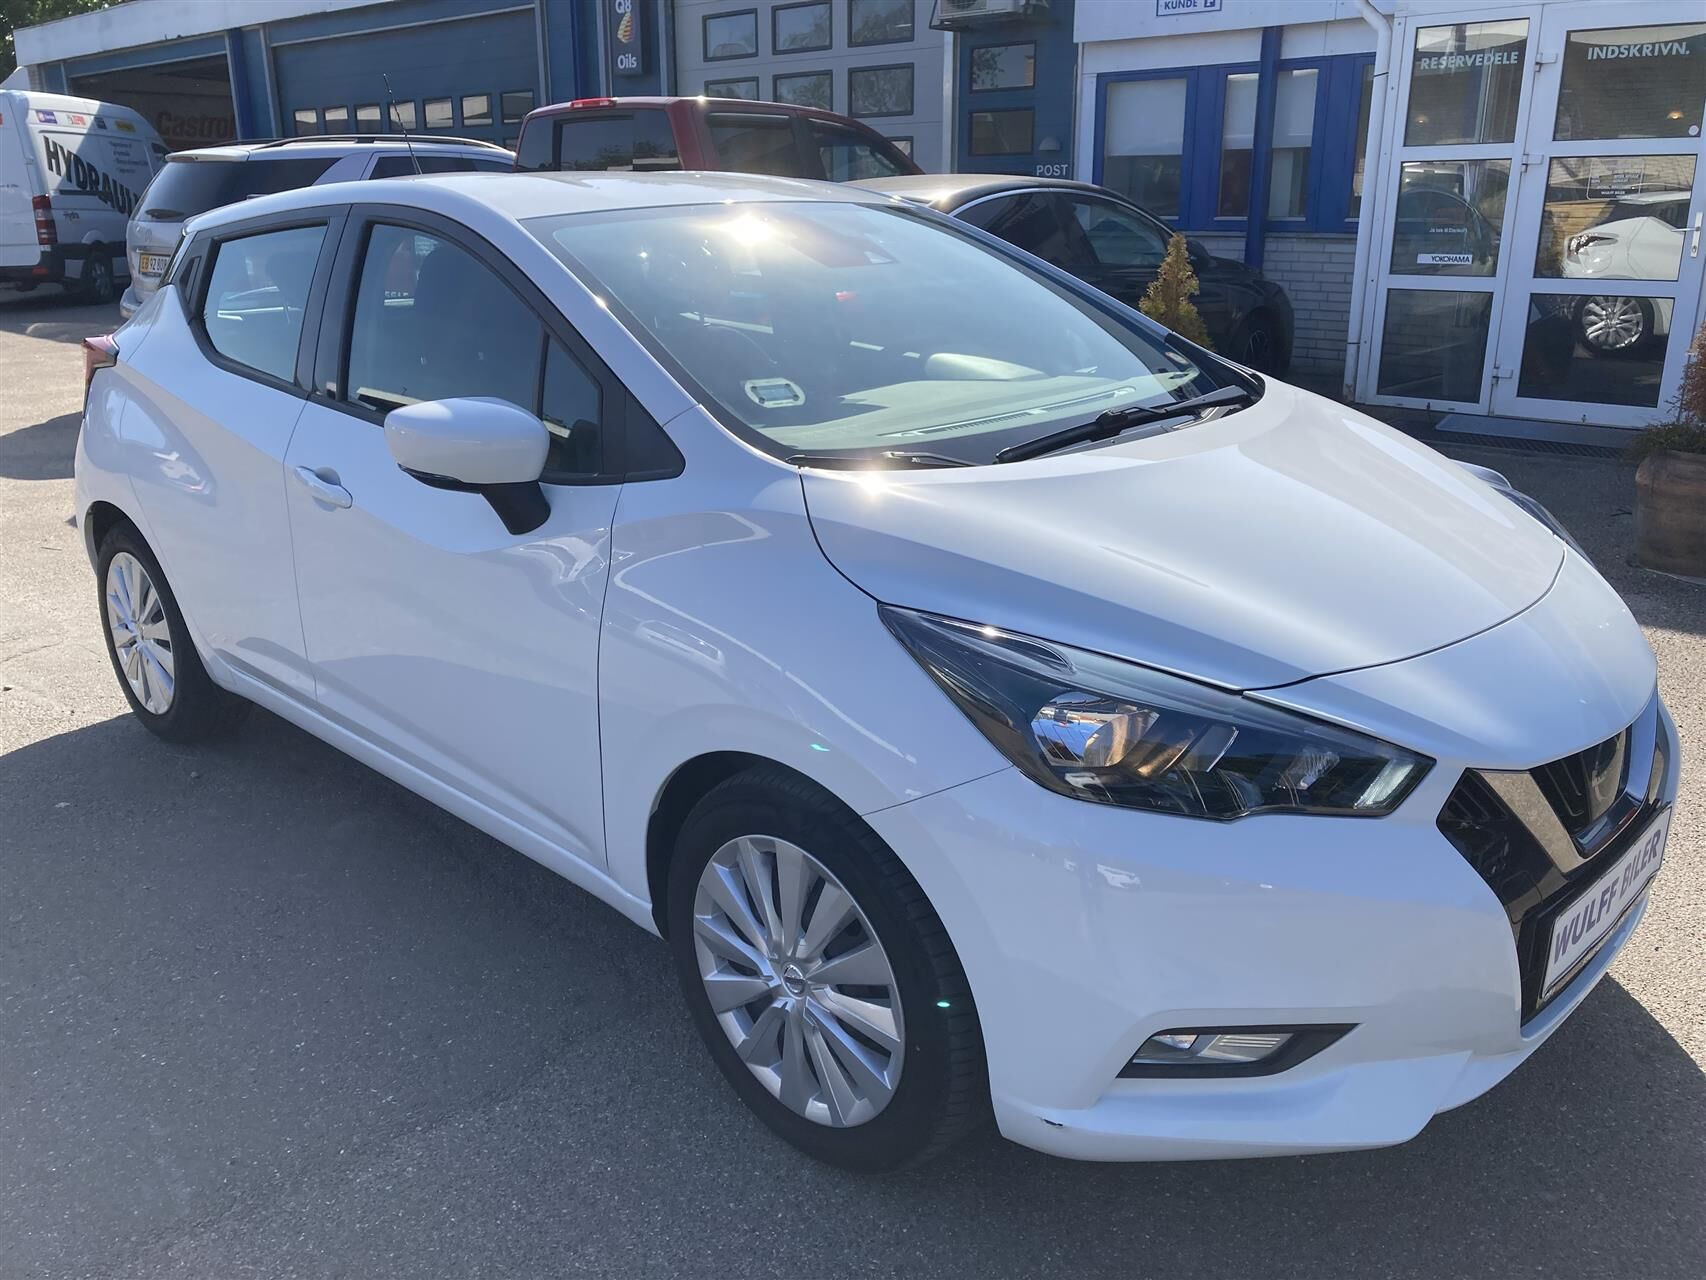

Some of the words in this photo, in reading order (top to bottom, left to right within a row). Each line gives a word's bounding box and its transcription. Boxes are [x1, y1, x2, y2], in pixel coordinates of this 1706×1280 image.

[1164, 0, 1198, 10] KUNDE
[1587, 42, 1690, 60] INDSKRIVN.
[617, 53, 637, 69] Oils
[1420, 51, 1518, 70] RESERVEDELE
[1036, 164, 1069, 176] POST
[1431, 255, 1470, 263] YOKOHAMA
[1553, 876, 1620, 964] WULFF
[1620, 829, 1661, 899] BILER
